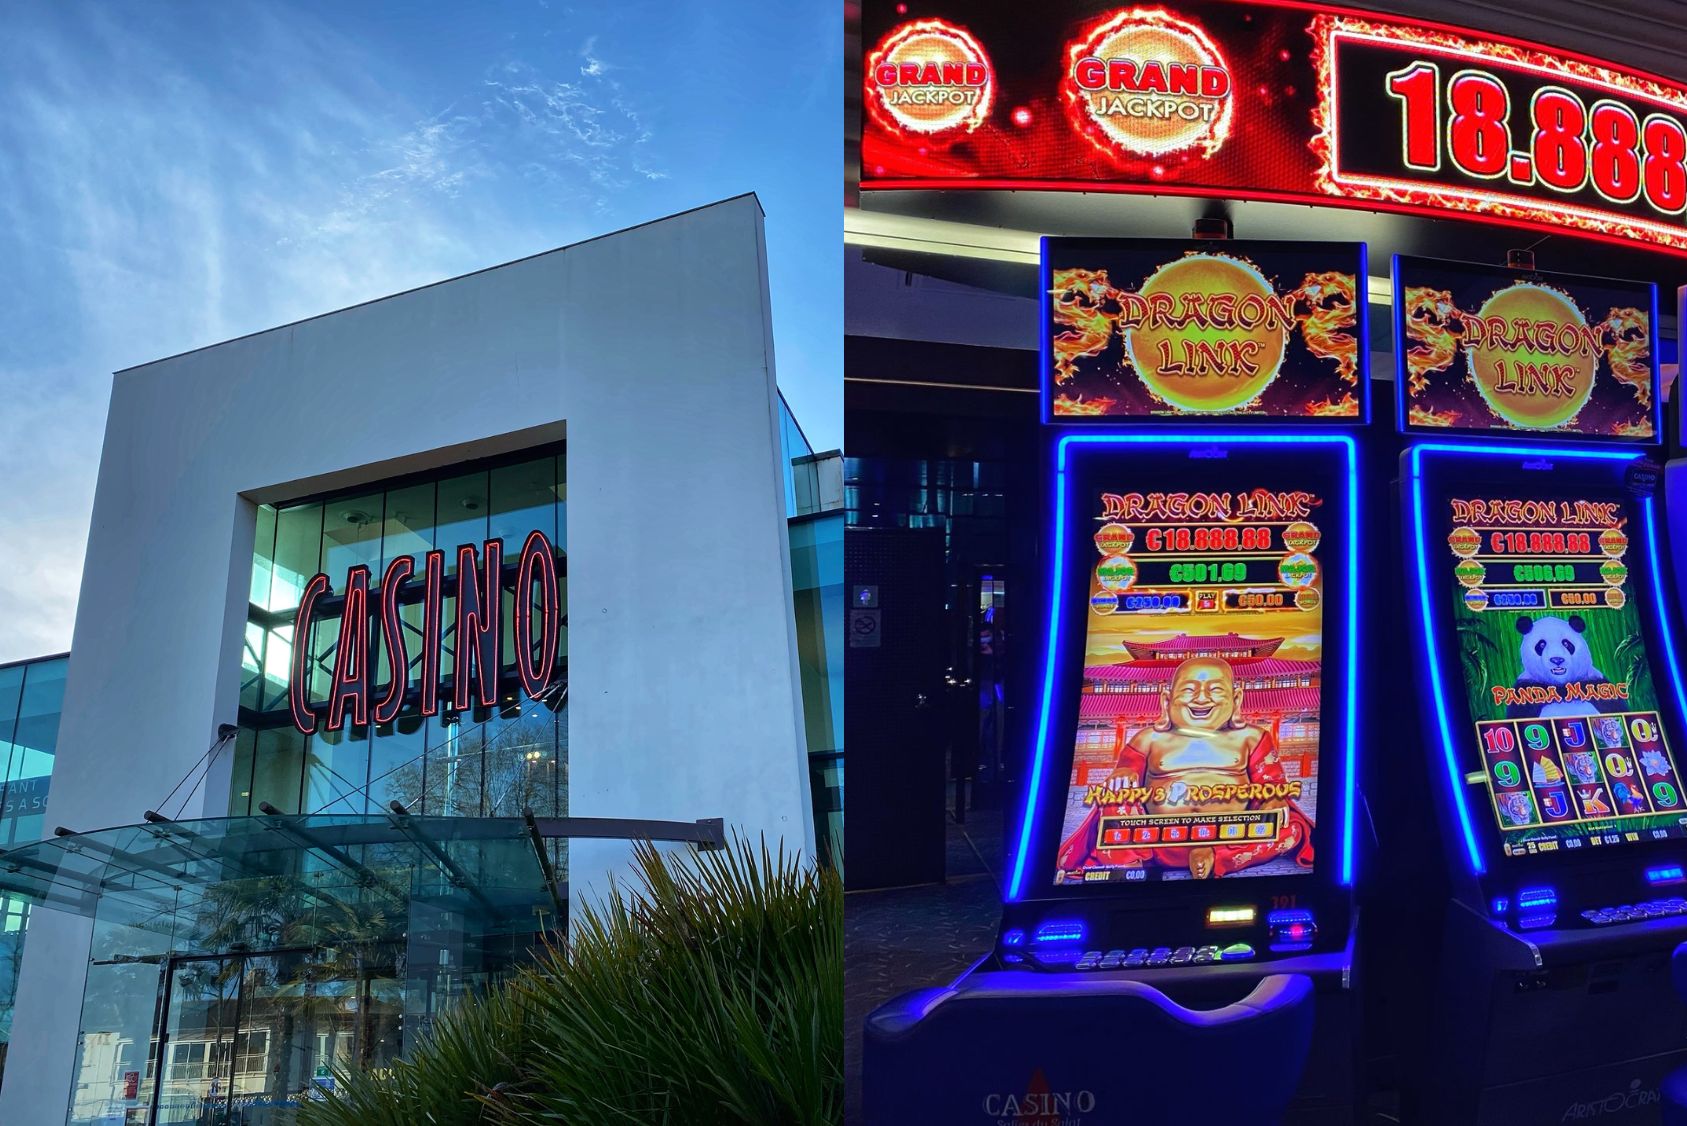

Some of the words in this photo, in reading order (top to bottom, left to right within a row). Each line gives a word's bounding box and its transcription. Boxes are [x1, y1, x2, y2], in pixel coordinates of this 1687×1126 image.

[874, 62, 989, 87] GRAND
[1074, 58, 1231, 99] GRAND
[889, 90, 977, 106] JACKPOT
[1095, 97, 1215, 122] JACKPOT
[1385, 61, 1687, 215] 18.888
[1117, 292, 1299, 332] DRAGON
[1460, 314, 1605, 358] DRAGON
[1101, 492, 1232, 520] DRAGON
[1450, 499, 1558, 524] DRAGON
[288, 529, 561, 736] CASINO
[1491, 685, 1563, 705] PANDA
[1565, 682, 1630, 701] MAGIC
[1484, 726, 1515, 754] 10
[1524, 724, 1550, 751] 9
[1564, 722, 1586, 748] J
[1631, 719, 1658, 743] Q
[1494, 760, 1521, 788] 9
[1605, 753, 1634, 778] Q
[1084, 785, 1152, 805] HAPPY
[1168, 781, 1302, 805] PROSPEROUS
[1545, 791, 1569, 818] J
[1652, 782, 1678, 808] 9
[1120, 819, 1147, 827] TOUCH
[1149, 817, 1180, 826] SCREEN
[1181, 817, 1191, 825] TO
[1193, 815, 1217, 824] MAKE
[1218, 814, 1261, 823] SELECTION
[1085, 870, 1111, 881] CREDIT
[983, 1090, 1096, 1117] CASINO
